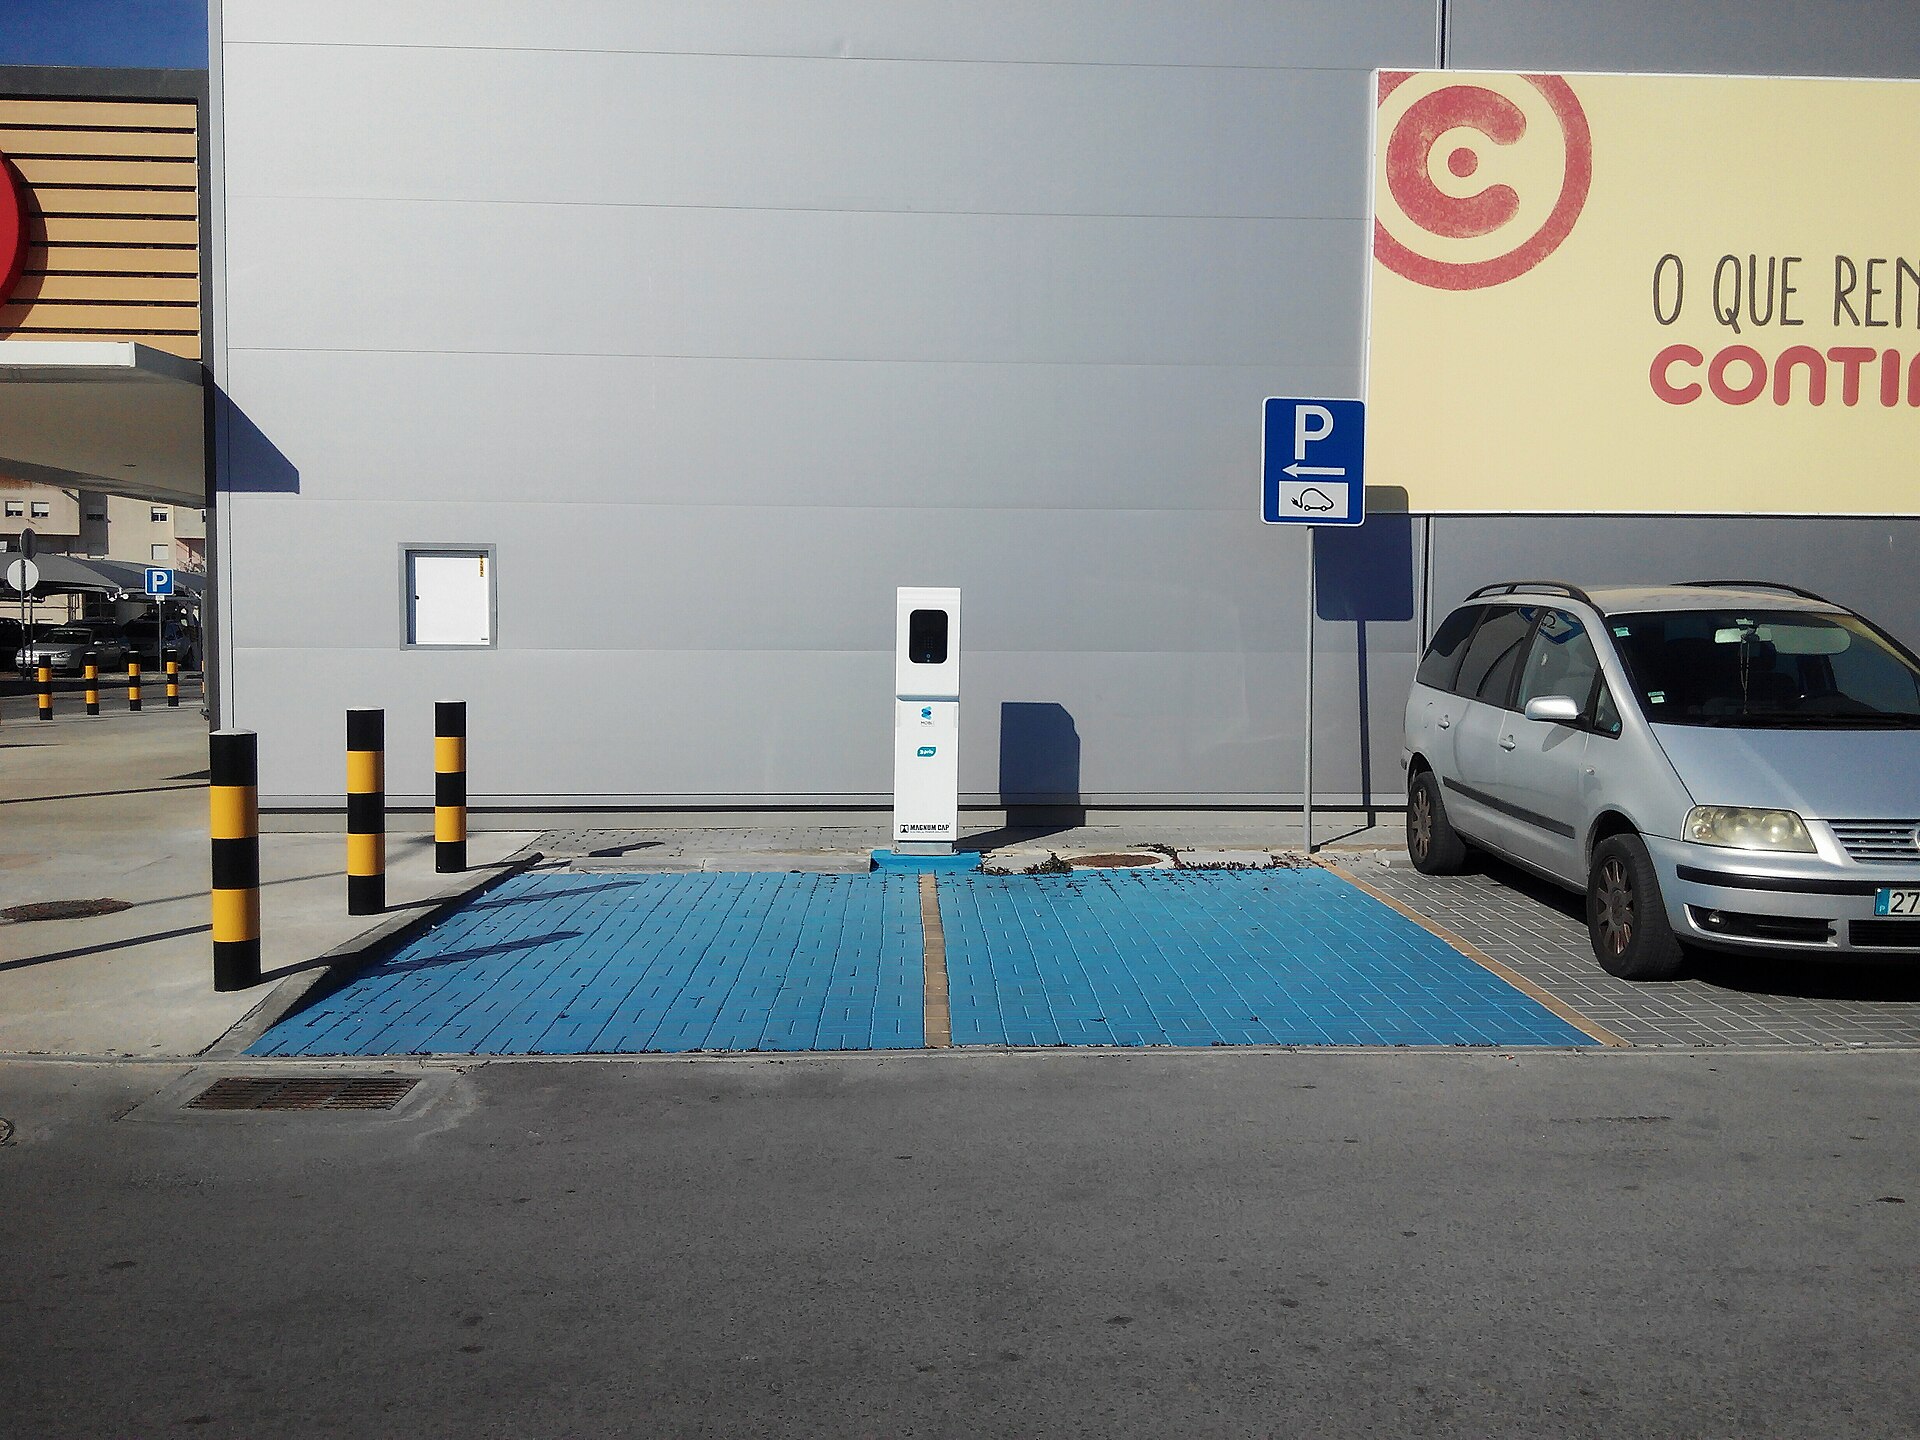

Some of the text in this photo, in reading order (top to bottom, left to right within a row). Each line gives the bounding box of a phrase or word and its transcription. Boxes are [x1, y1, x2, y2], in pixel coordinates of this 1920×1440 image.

[1653, 253, 1684, 326] O
[1713, 253, 1804, 334] QUE
[1649, 343, 1920, 408] CONTI
[1295, 404, 1334, 460] P
[152, 571, 168, 592] P
